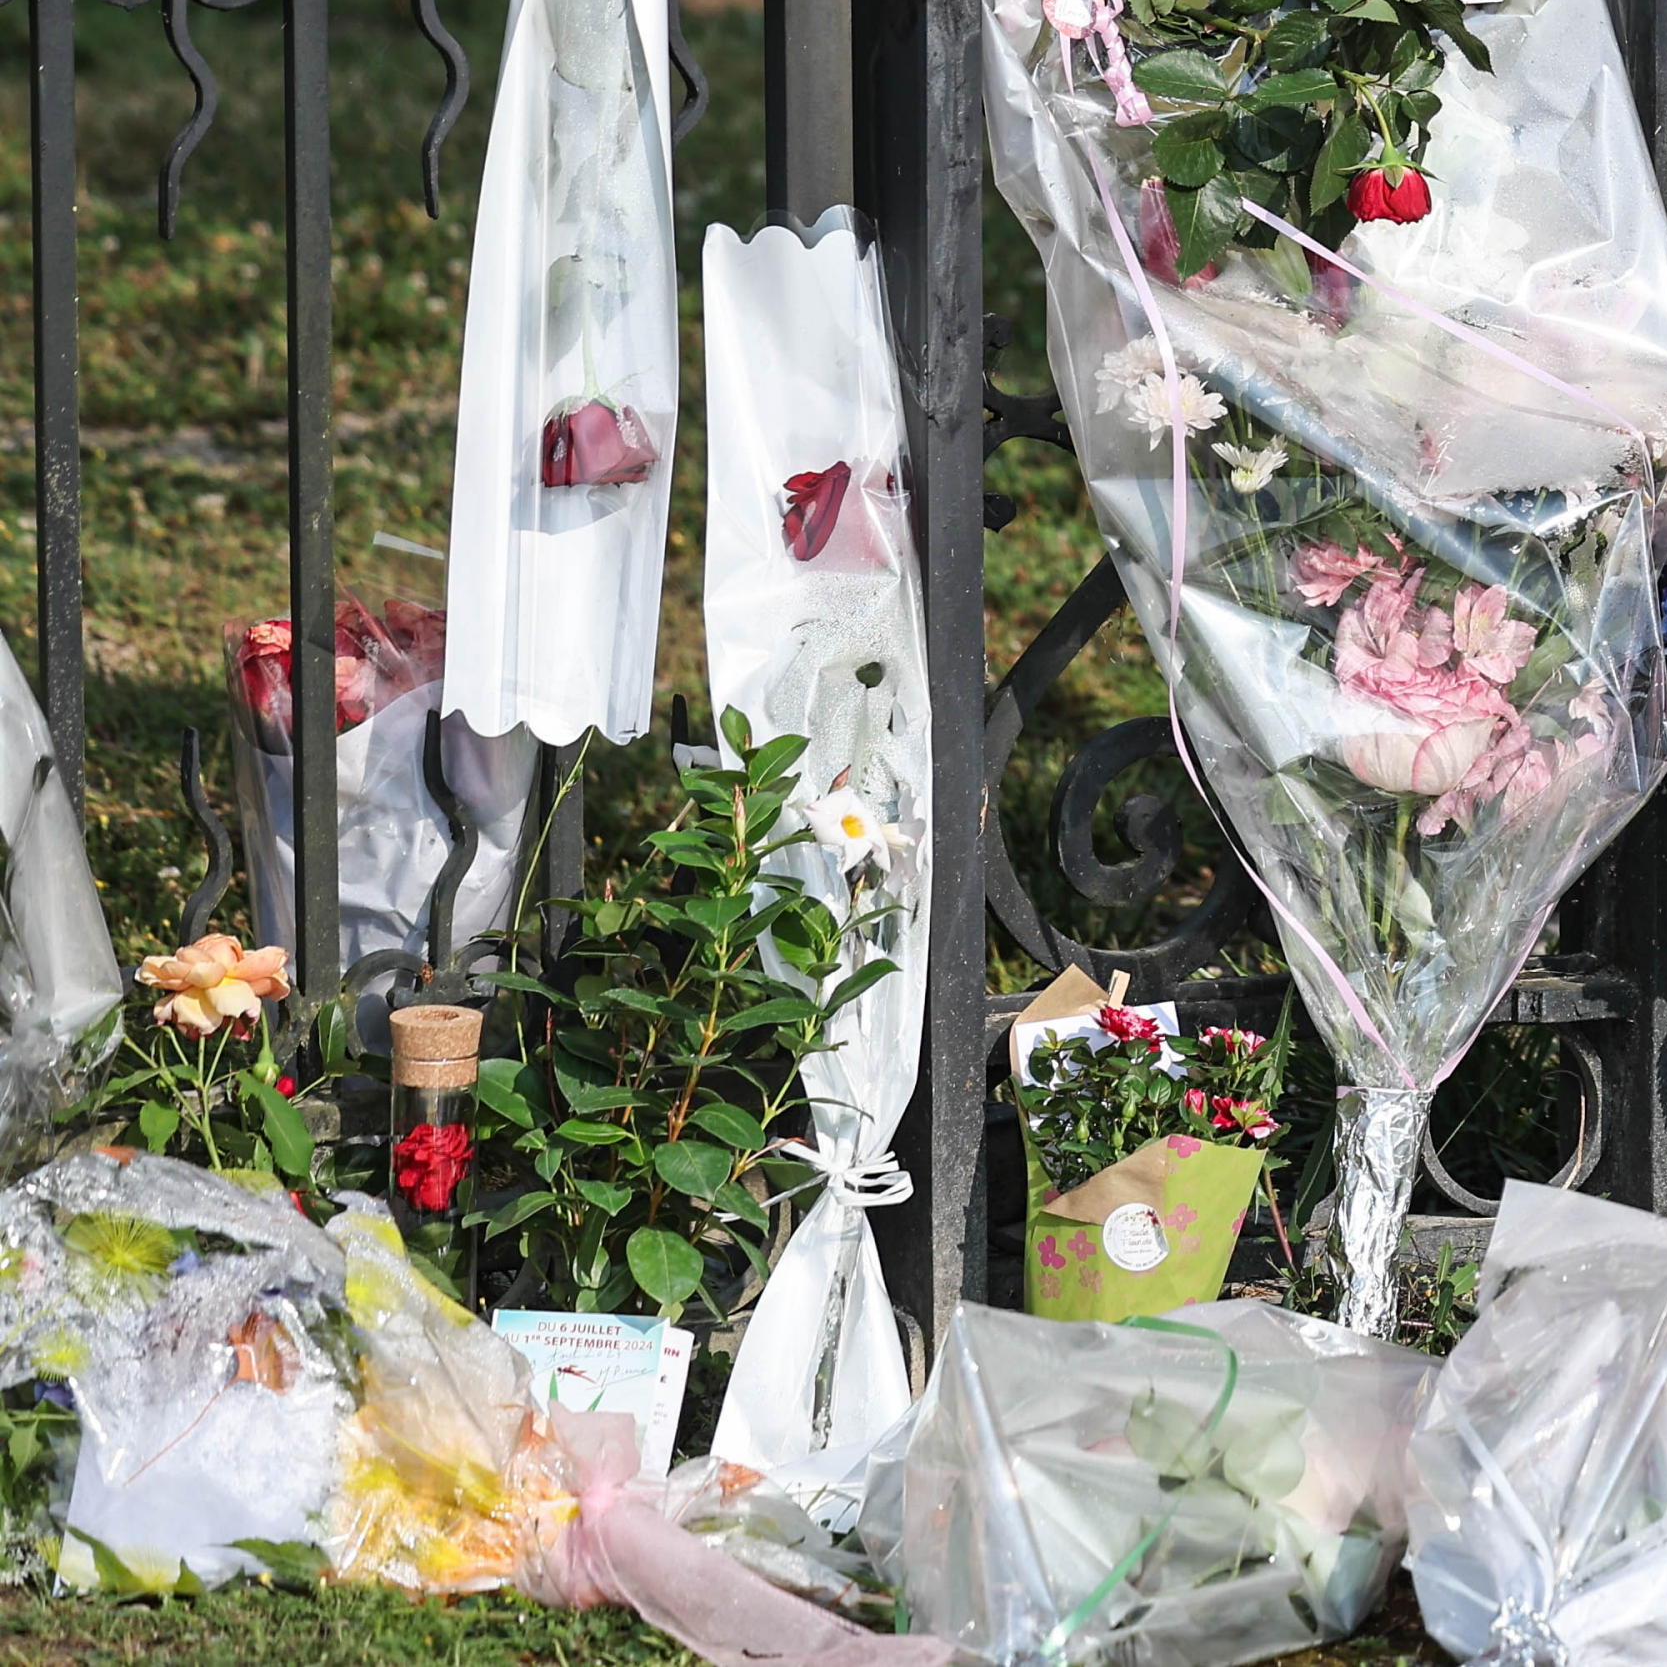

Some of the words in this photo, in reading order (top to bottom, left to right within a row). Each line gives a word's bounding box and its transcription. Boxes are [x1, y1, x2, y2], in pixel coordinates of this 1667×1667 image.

[538, 1321, 556, 1332] DU
[560, 1323, 567, 1332] 6
[570, 1323, 622, 1336] JUILLET
[501, 1333, 520, 1344] AU
[544, 1336, 620, 1350] SEPTEMBRE
[624, 1340, 653, 1350] 2024
